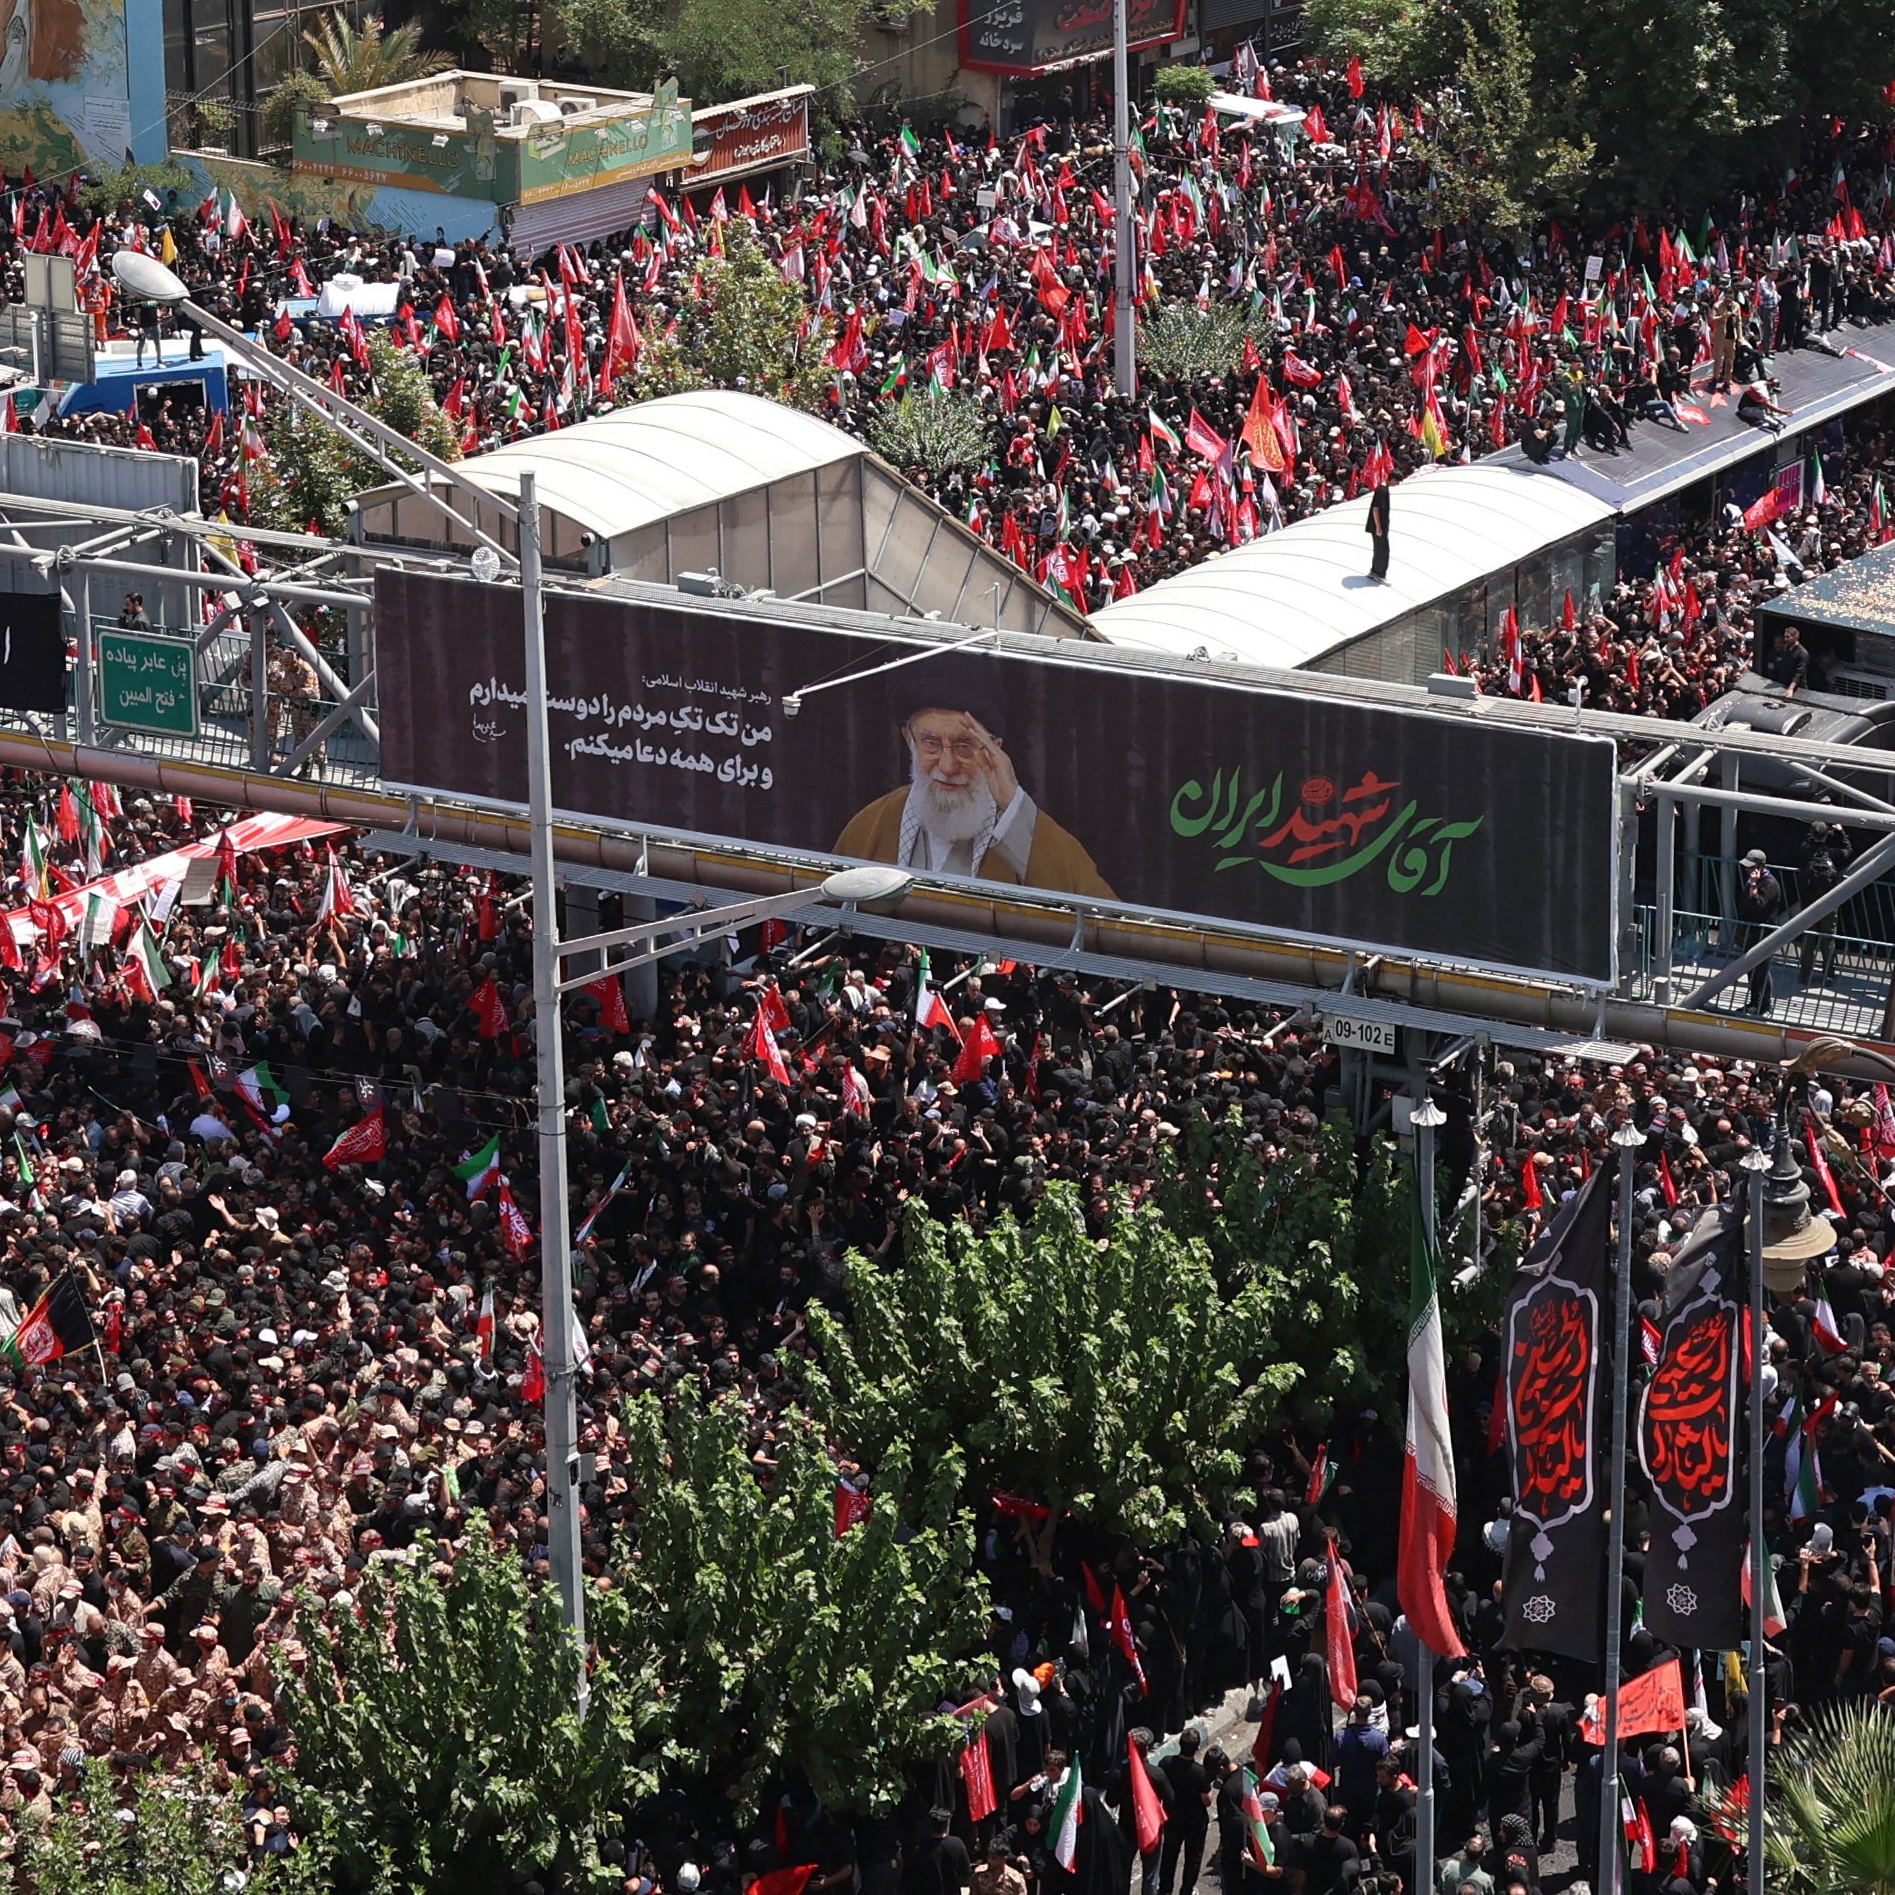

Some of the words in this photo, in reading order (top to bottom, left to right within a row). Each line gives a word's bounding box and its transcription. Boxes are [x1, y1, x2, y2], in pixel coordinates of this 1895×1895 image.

[984, 7, 1024, 30] فریزر
[978, 30, 1025, 55] سردخانه
[346, 136, 459, 168] MACHINELLO
[568, 134, 649, 167] MACHINELLO
[106, 647, 137, 672] پیاده
[140, 652, 166, 673] عابر
[641, 673, 684, 690] اسلامی:
[683, 678, 719, 694] انقلاب
[719, 685, 747, 700] شهید
[119, 686, 152, 707] المبین
[155, 689, 175, 714] فتح
[603, 692, 616, 725] را
[748, 687, 772, 705] رهبر
[617, 701, 668, 731] مردم
[705, 709, 740, 737] تک
[740, 720, 773, 747] من
[635, 737, 668, 766] دعا
[669, 747, 715, 774] همه
[716, 753, 759, 787] برای
[761, 765, 774, 790] و
[1169, 764, 1284, 872] ایران
[1258, 769, 1403, 864] شهید
[1258, 798, 1485, 896] آقای
[1323, 1028, 1333, 1042] A
[1335, 1019, 1382, 1045] 09-102
[1383, 1032, 1394, 1047] E
